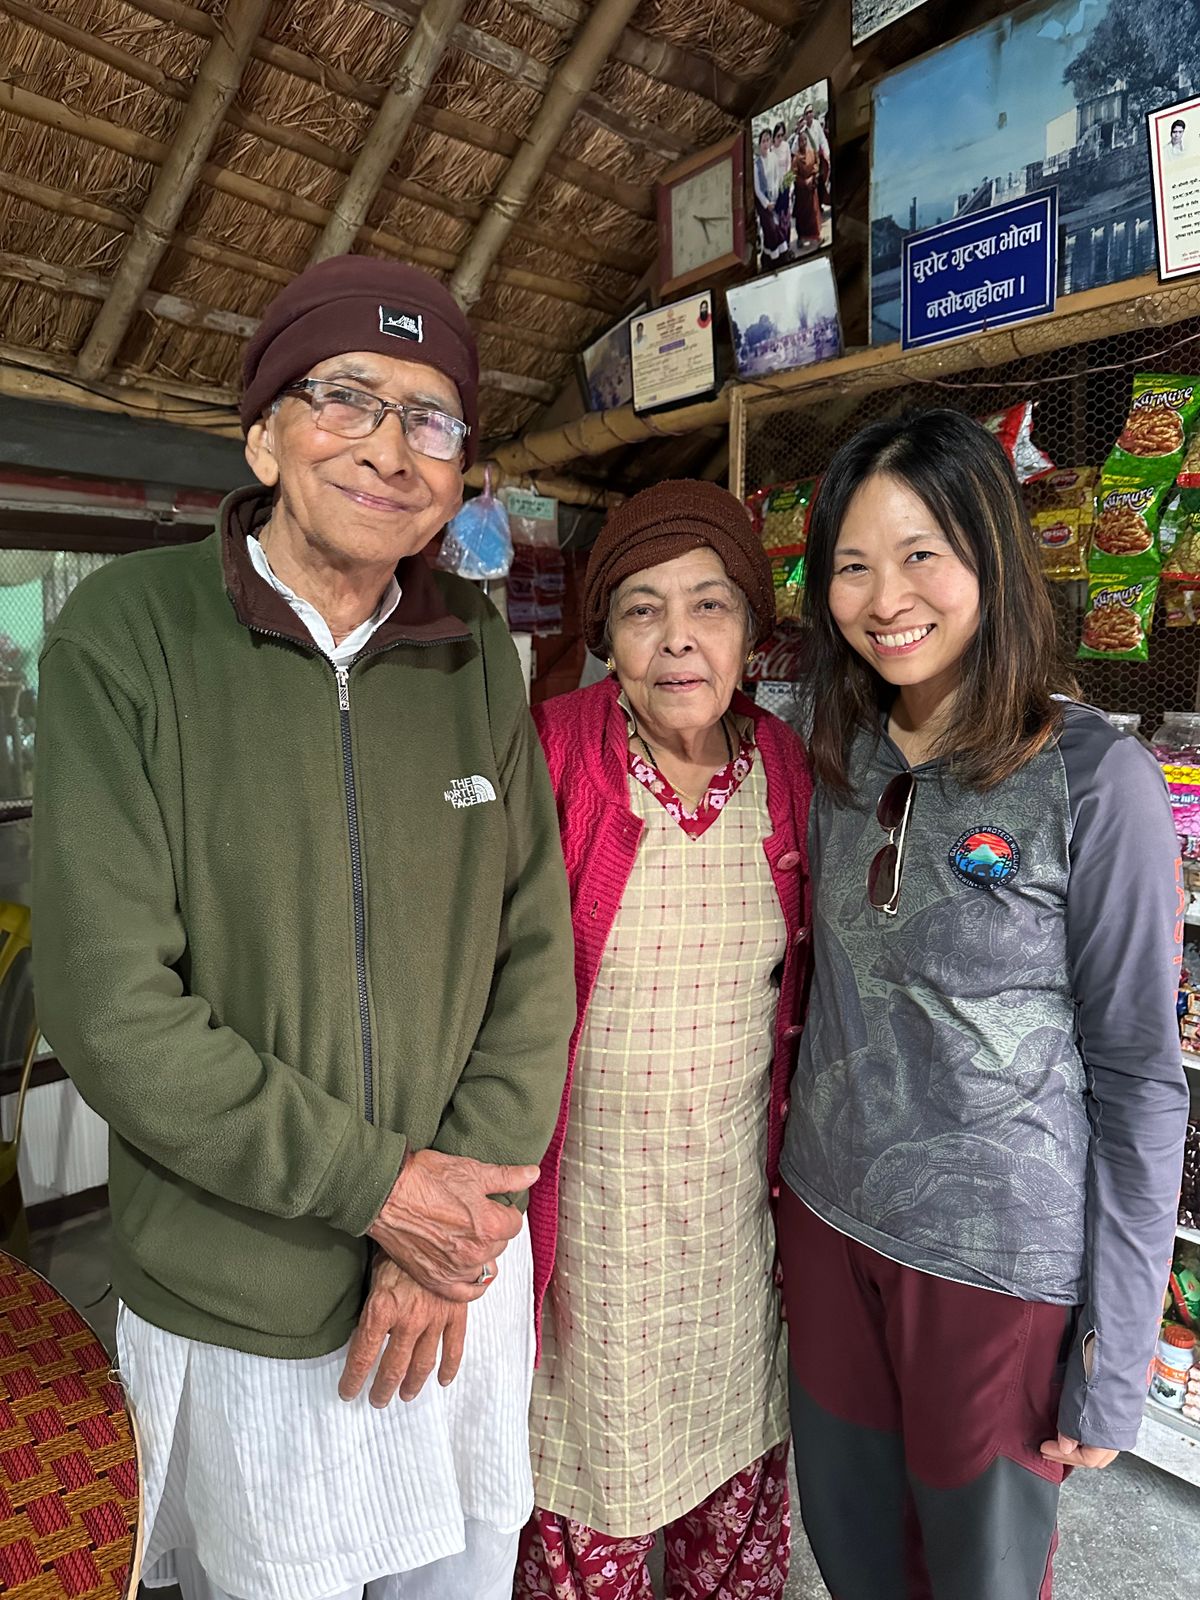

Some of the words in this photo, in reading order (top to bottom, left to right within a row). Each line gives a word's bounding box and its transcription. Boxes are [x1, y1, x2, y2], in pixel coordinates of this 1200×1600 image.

[450, 777, 472, 789] THE
[443, 785, 476, 802] NORTH
[450, 796, 478, 809] FACE
[982, 826, 1012, 843] PROTECT
[1010, 842, 1020, 874] WILDLIFE
